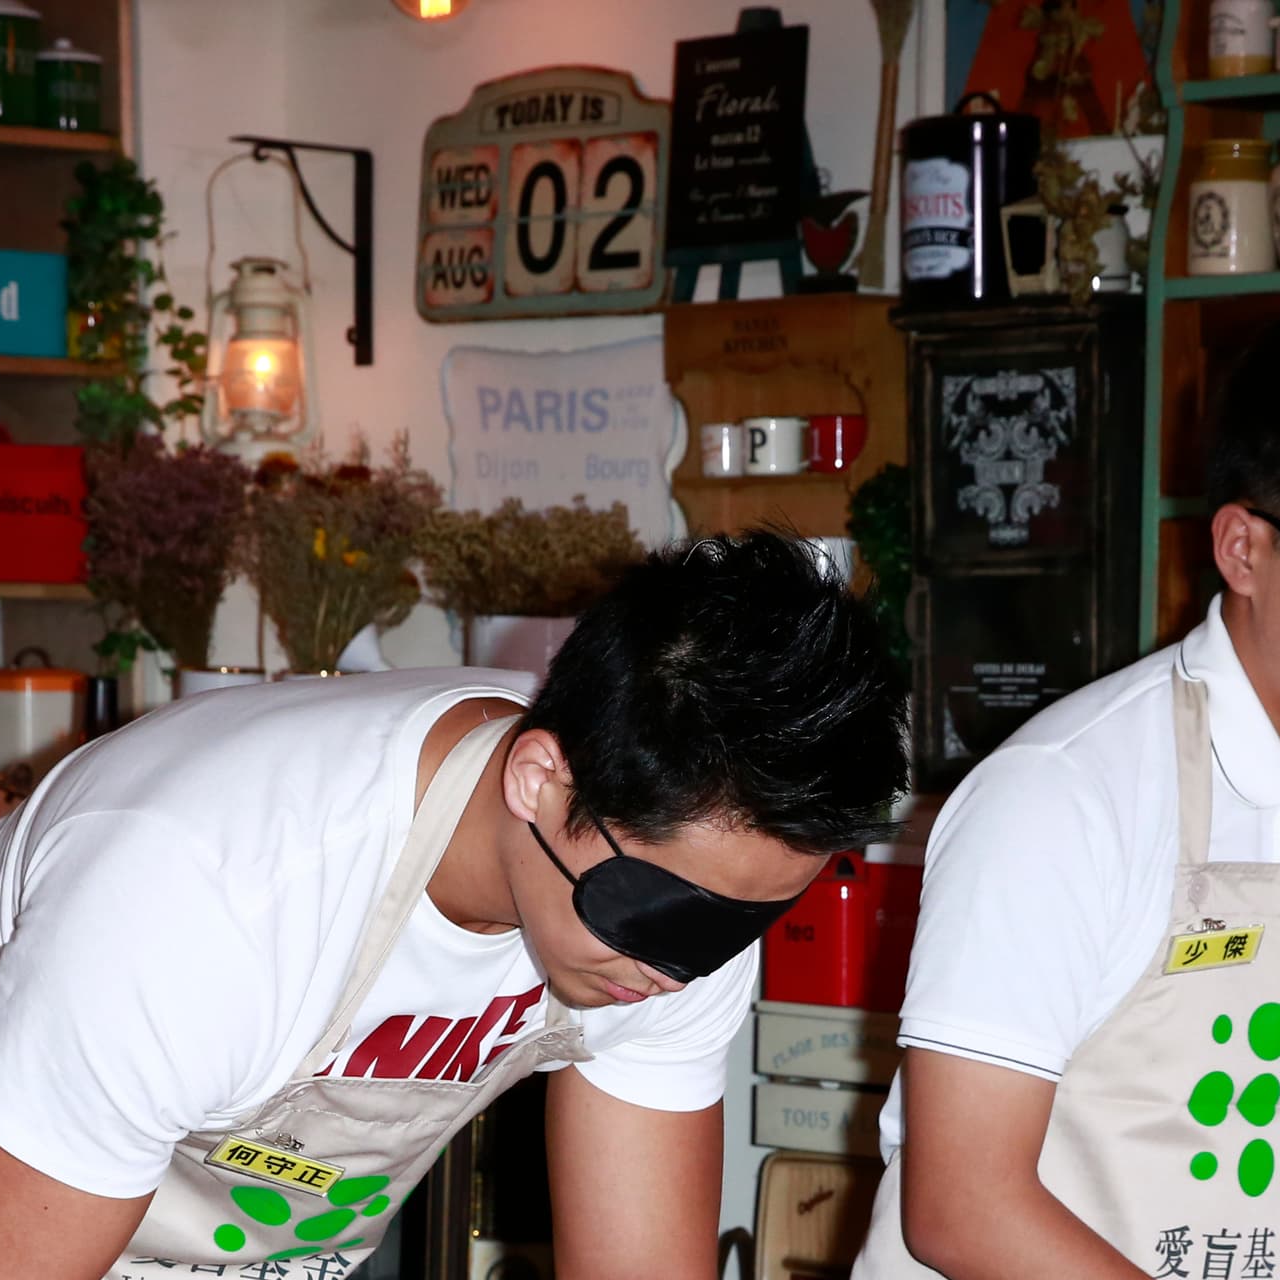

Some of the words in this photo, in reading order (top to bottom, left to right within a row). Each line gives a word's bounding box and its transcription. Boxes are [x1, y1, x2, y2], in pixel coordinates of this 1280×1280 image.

[496, 95, 572, 132] TODAY
[581, 93, 604, 121] IS
[436, 163, 492, 209] WED
[517, 155, 646, 276] 02
[432, 245, 488, 291] AUG
[477, 387, 610, 433] PARIS
[750, 429, 767, 462] P
[784, 922, 815, 942] tea
[1181, 933, 1248, 966] 少傑
[781, 1107, 830, 1129] TOUS
[227, 1143, 333, 1189] 何守正
